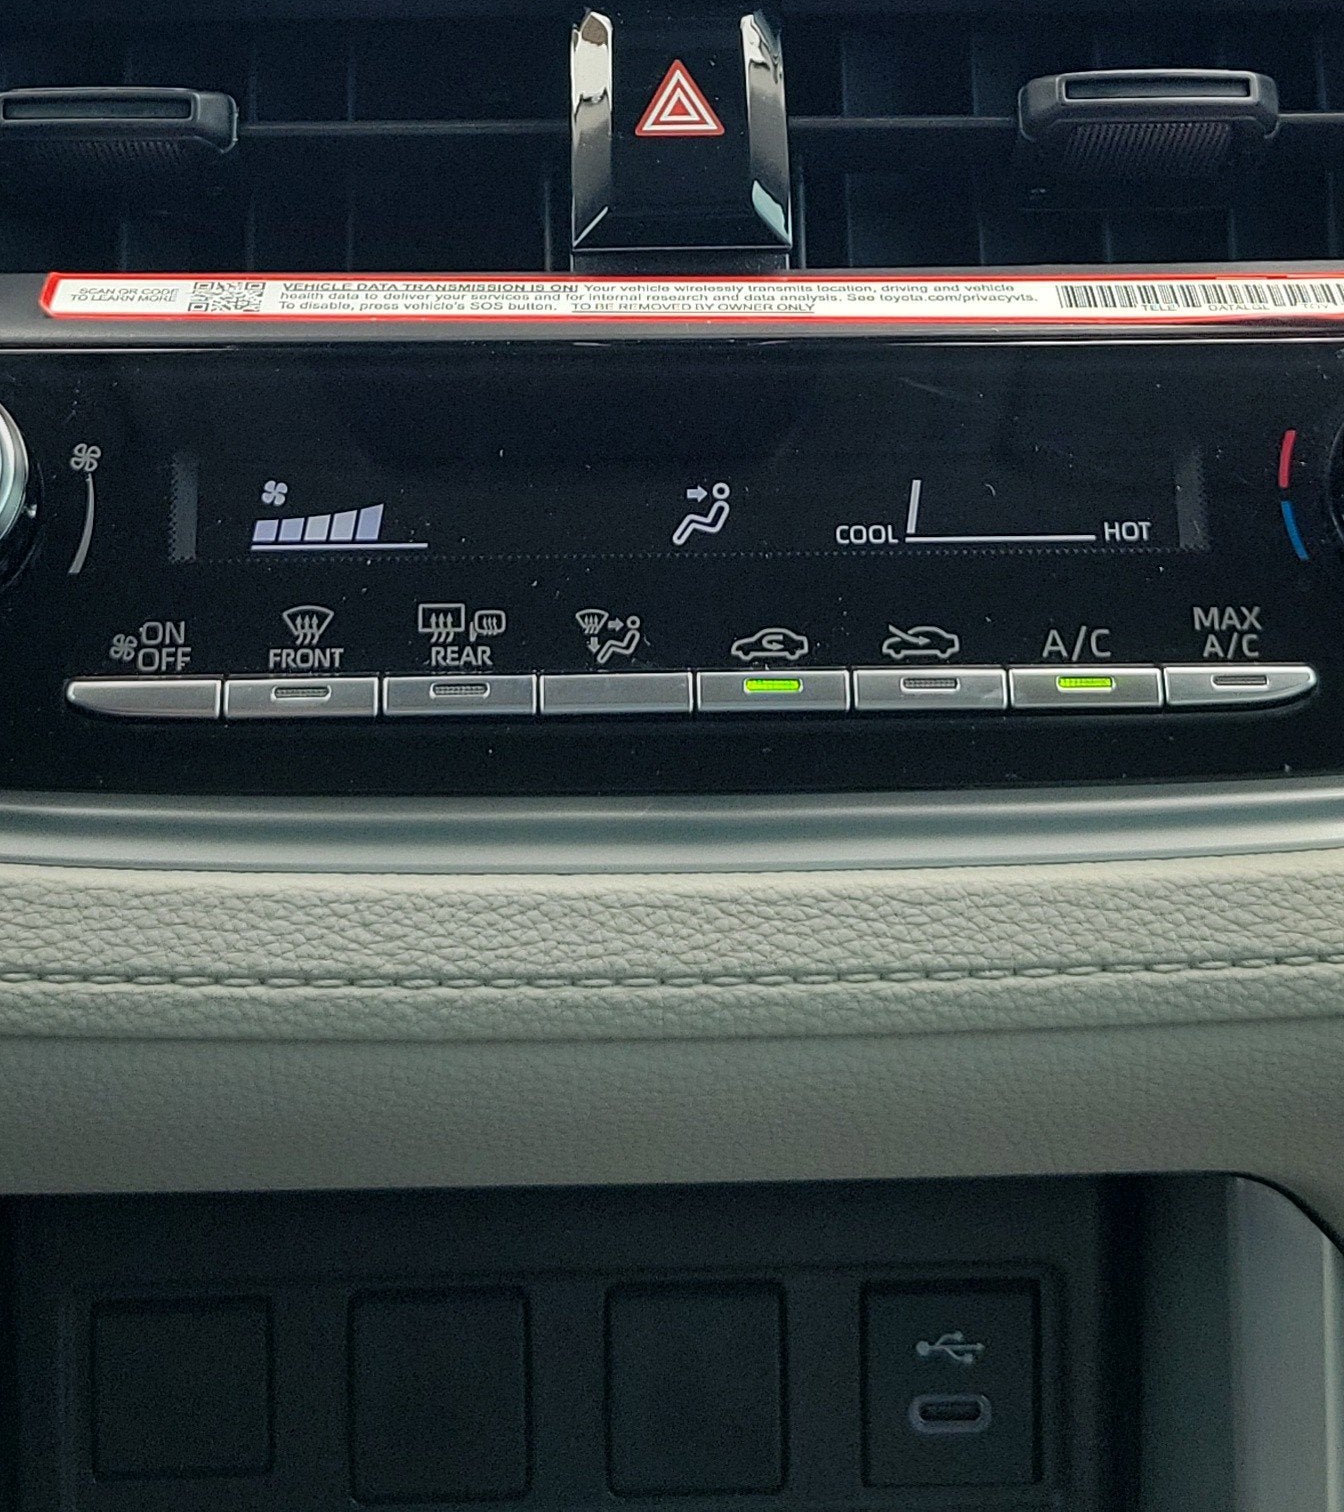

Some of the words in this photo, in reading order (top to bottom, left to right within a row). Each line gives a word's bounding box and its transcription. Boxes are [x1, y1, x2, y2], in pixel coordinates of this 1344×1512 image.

[280, 292, 324, 300] health
[328, 292, 360, 300] data
[365, 292, 379, 300] to
[383, 292, 431, 300] deliver
[435, 293, 466, 302] your
[471, 292, 528, 300] services
[534, 293, 561, 301] and
[565, 293, 585, 301] for
[589, 293, 641, 301] internal
[646, 293, 706, 301] research
[713, 293, 739, 301] and
[744, 293, 775, 301] data
[779, 293, 843, 302] analysis.
[847, 293, 875, 301] See
[283, 282, 353, 292] VEHICLE
[357, 282, 397, 292] DATA
[401, 283, 525, 292] TRANSMISSION
[531, 283, 545, 292] IS
[550, 284, 578, 293] ON!
[584, 284, 616, 292] Your
[621, 284, 671, 292] vehicle
[674, 284, 743, 294] wirelessly
[748, 284, 812, 292] transmits
[817, 284, 877, 293] location,
[881, 284, 928, 294] driving
[933, 284, 960, 292] and
[964, 284, 1015, 292] vehicle
[71, 294, 88, 302] TO
[91, 294, 138, 303] LEARN
[278, 300, 295, 310] To
[299, 300, 355, 311] disable,
[359, 302, 399, 311] press
[403, 301, 465, 310] vehicle's
[470, 301, 504, 310] SOS
[508, 301, 557, 311] button.
[571, 302, 592, 311] TO
[595, 302, 613, 311] BE
[618, 302, 692, 311] REMOVED
[695, 302, 714, 311] BY
[717, 302, 773, 311] OWNER
[777, 302, 816, 311] ONLY
[835, 525, 899, 544] COOL
[1104, 521, 1152, 541] HOT
[1192, 606, 1263, 630] MAX
[141, 621, 186, 646] ON
[1042, 624, 1112, 658] A/C
[1202, 633, 1260, 658] A/C
[136, 647, 192, 672] OFF
[269, 647, 344, 668] FRONT
[430, 646, 493, 666] REAR
